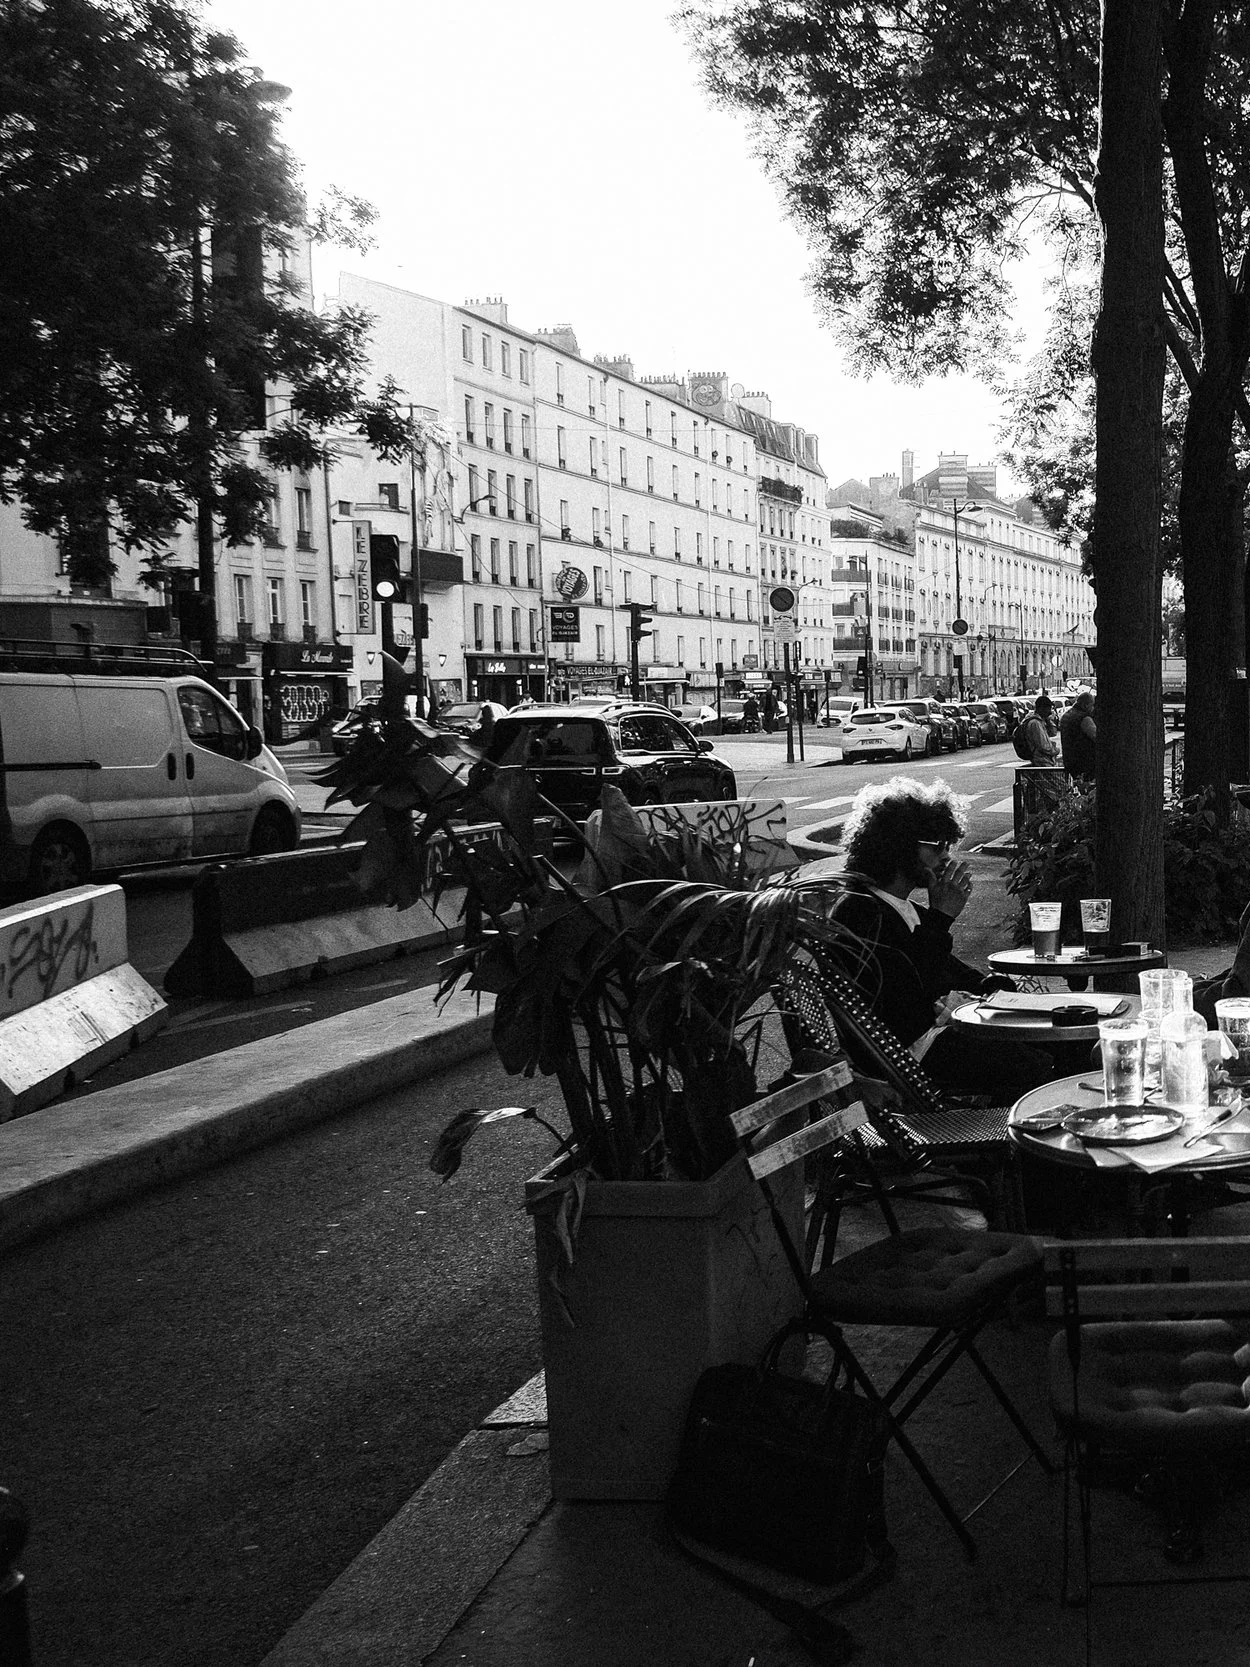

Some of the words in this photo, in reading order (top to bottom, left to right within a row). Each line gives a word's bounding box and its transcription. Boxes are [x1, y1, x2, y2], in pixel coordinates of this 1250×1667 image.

[355, 526, 366, 554] LE
[357, 559, 370, 629] ZEBRE
[560, 569, 581, 595] VOYAGES
